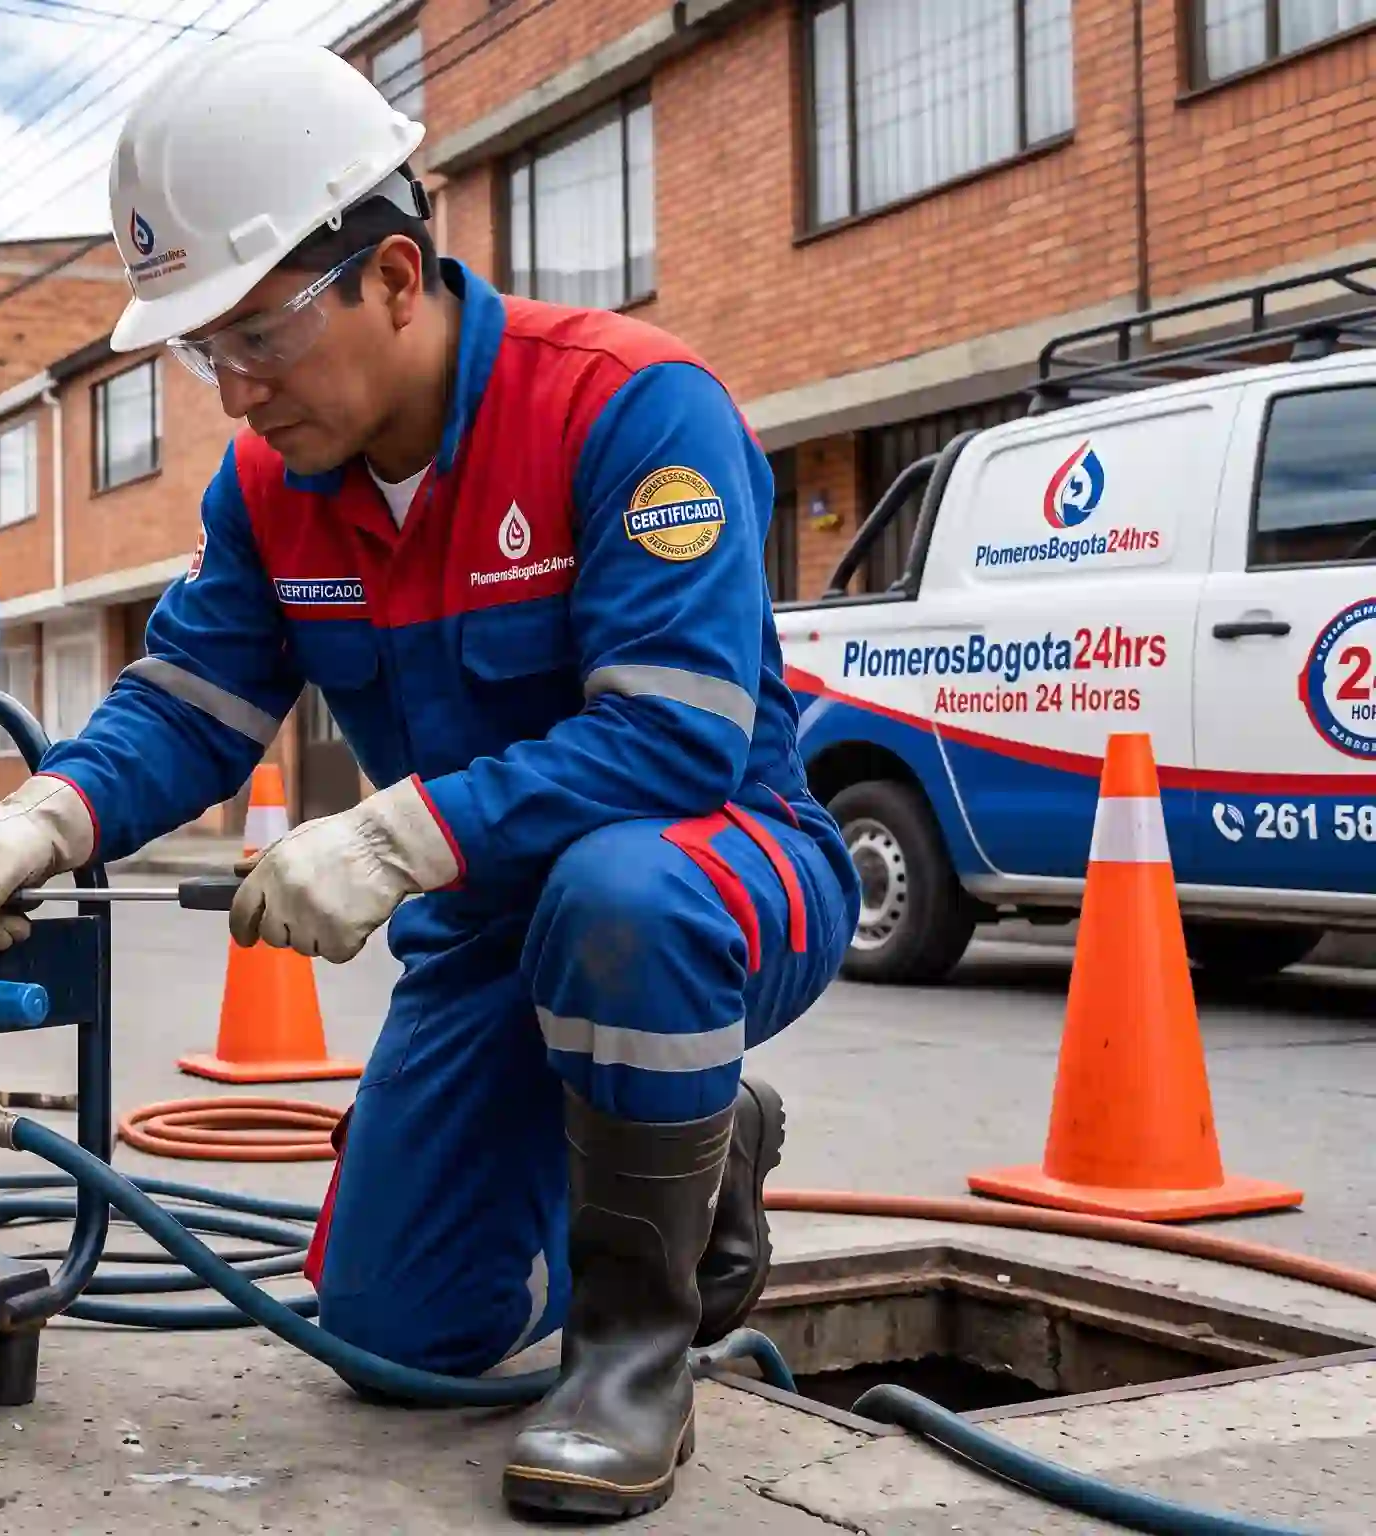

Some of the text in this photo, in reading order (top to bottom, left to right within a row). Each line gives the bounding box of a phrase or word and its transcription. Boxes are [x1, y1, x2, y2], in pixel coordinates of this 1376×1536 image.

[631, 502, 719, 530] CERTIFICADO
[976, 528, 1160, 567] PlomerosBogota24hrs
[280, 584, 363, 598] CERTIFICADO
[843, 626, 1167, 682] PlomerosBogota24hrs
[1336, 646, 1376, 701] 2
[934, 683, 1141, 714] Atencion 24 Horas
[1254, 802, 1376, 842] 261 58
